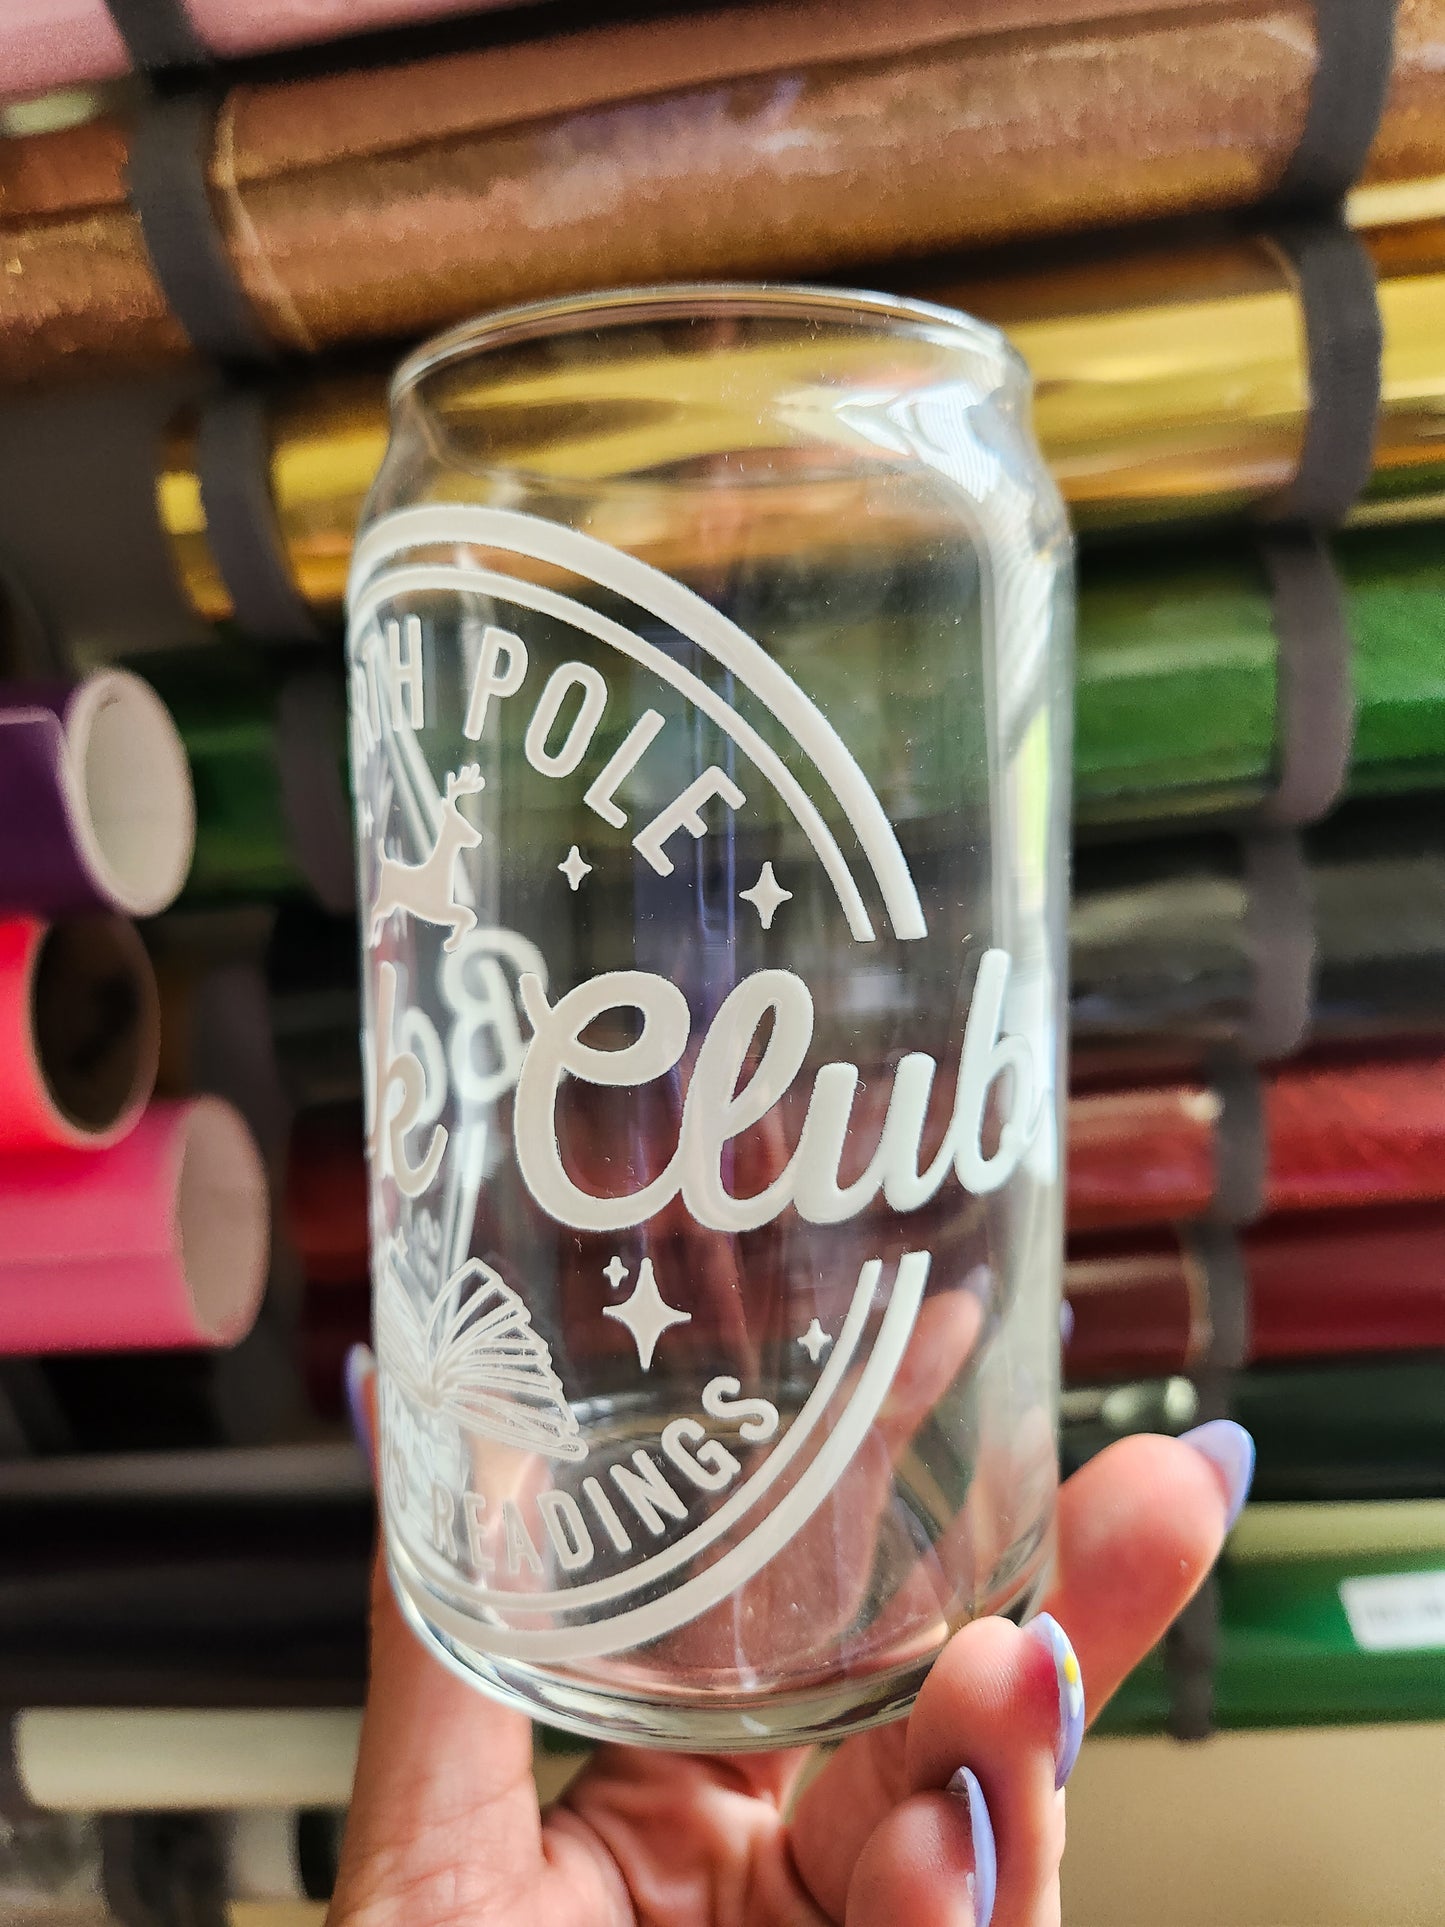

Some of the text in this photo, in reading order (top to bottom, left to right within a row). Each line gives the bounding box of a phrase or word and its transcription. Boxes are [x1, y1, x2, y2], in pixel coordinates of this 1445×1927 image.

[464, 626, 747, 877] POLE
[515, 947, 1050, 1233] Club
[431, 1375, 780, 1576] READINGS
